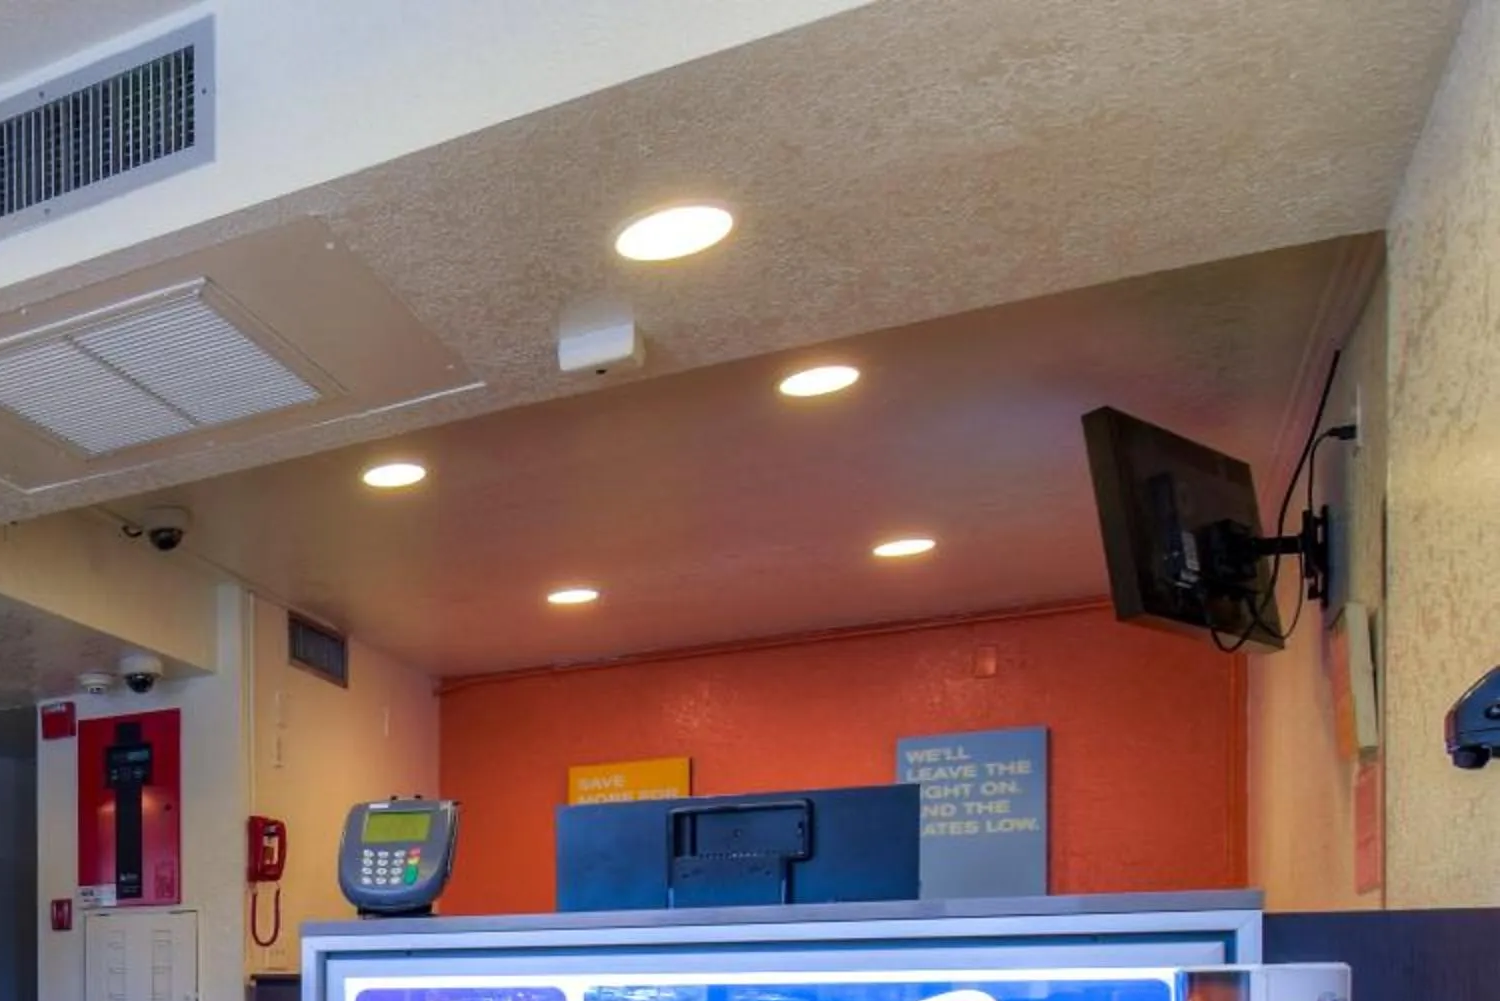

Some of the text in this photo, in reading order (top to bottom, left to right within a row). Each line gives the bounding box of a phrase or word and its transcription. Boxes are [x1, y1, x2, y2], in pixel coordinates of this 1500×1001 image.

[906, 745, 971, 763] WE'LL
[906, 758, 1033, 783] LEAVE THE
[578, 773, 626, 791] SAVE
[920, 783, 972, 800] IGHT
[923, 799, 1011, 818] ND THE
[923, 820, 979, 836] ATES
